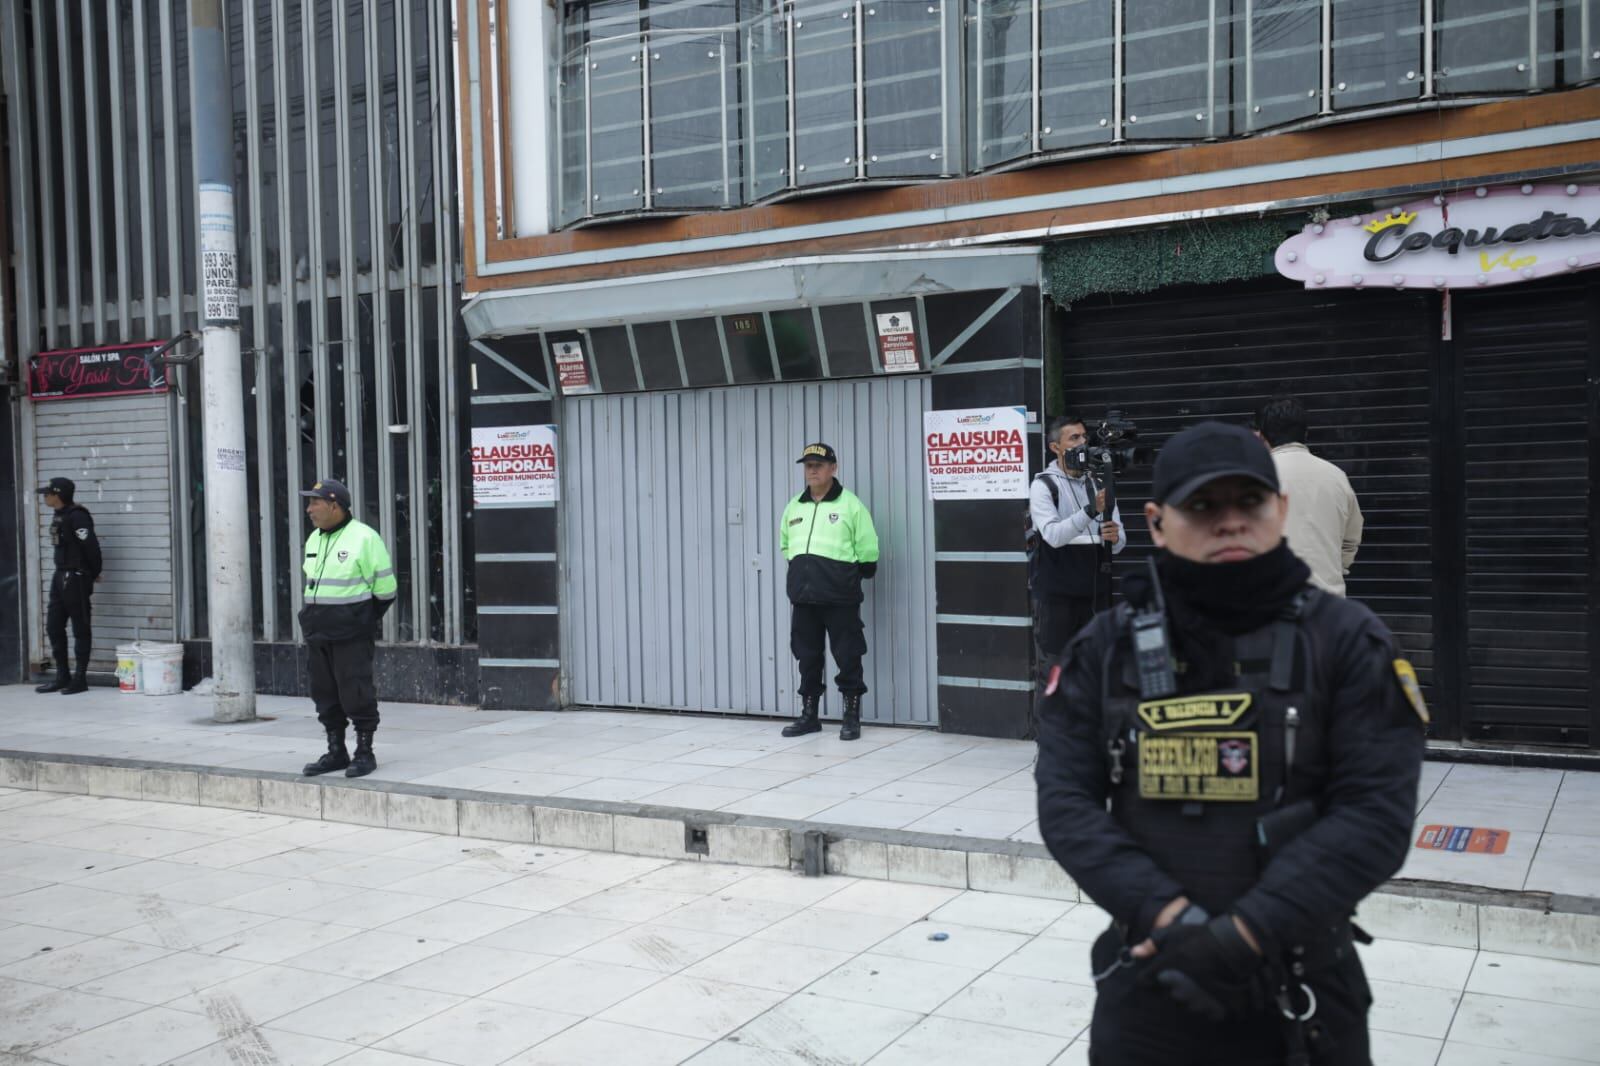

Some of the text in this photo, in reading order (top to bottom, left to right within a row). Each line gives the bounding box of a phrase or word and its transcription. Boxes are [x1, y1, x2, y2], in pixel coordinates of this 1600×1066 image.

[206, 267, 234, 279] UNION
[108, 353, 120, 362] SPA
[927, 429, 1022, 447] CLAUSURA
[472, 443, 554, 459] CLAUSURA
[929, 447, 1020, 464] TEMPORAL
[472, 458, 553, 473] TEMPORAL
[945, 466, 975, 474] ORDEN
[976, 465, 1024, 473] MUNICIPAL
[514, 472, 556, 480] MUNICIPAL
